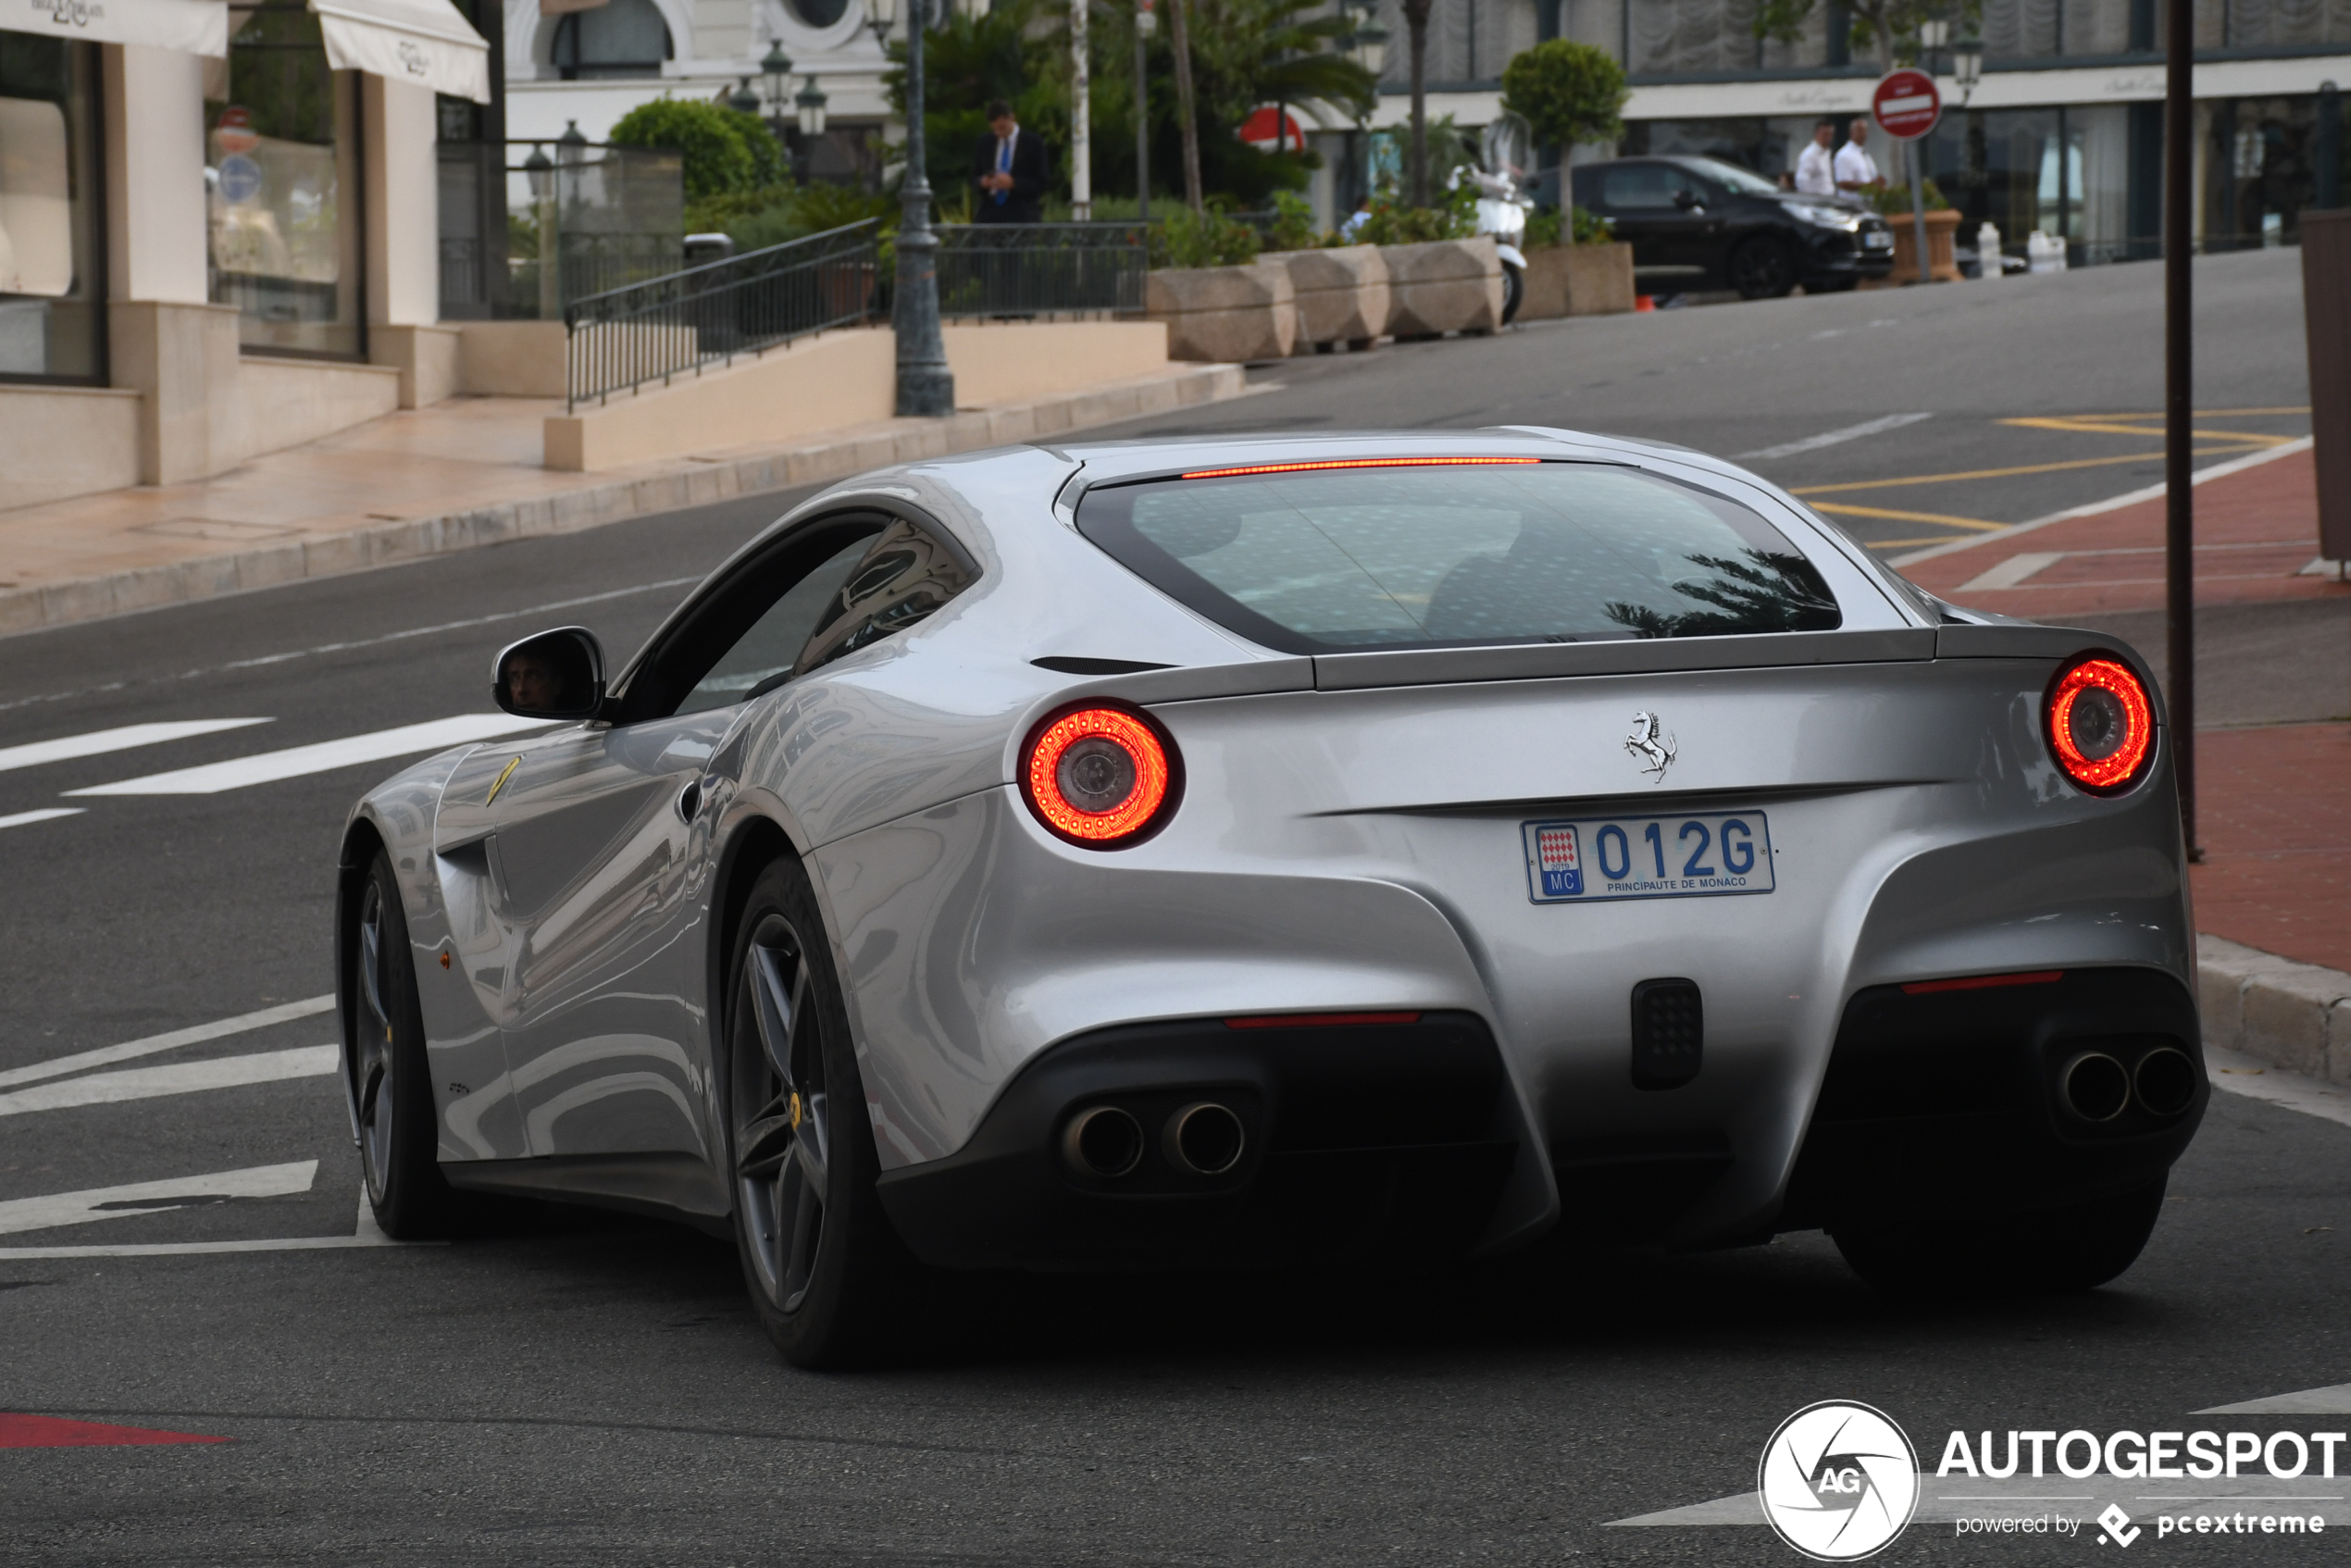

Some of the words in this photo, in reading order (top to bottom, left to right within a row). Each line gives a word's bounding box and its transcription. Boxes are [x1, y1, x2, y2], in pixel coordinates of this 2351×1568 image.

[1596, 818, 1755, 880] 012G
[1550, 863, 1570, 871] 2019
[1550, 872, 1574, 890] MC
[1607, 879, 1677, 892] PRINCIPAUTE
[1681, 878, 1696, 889] DE
[1699, 877, 1747, 888] MONACO
